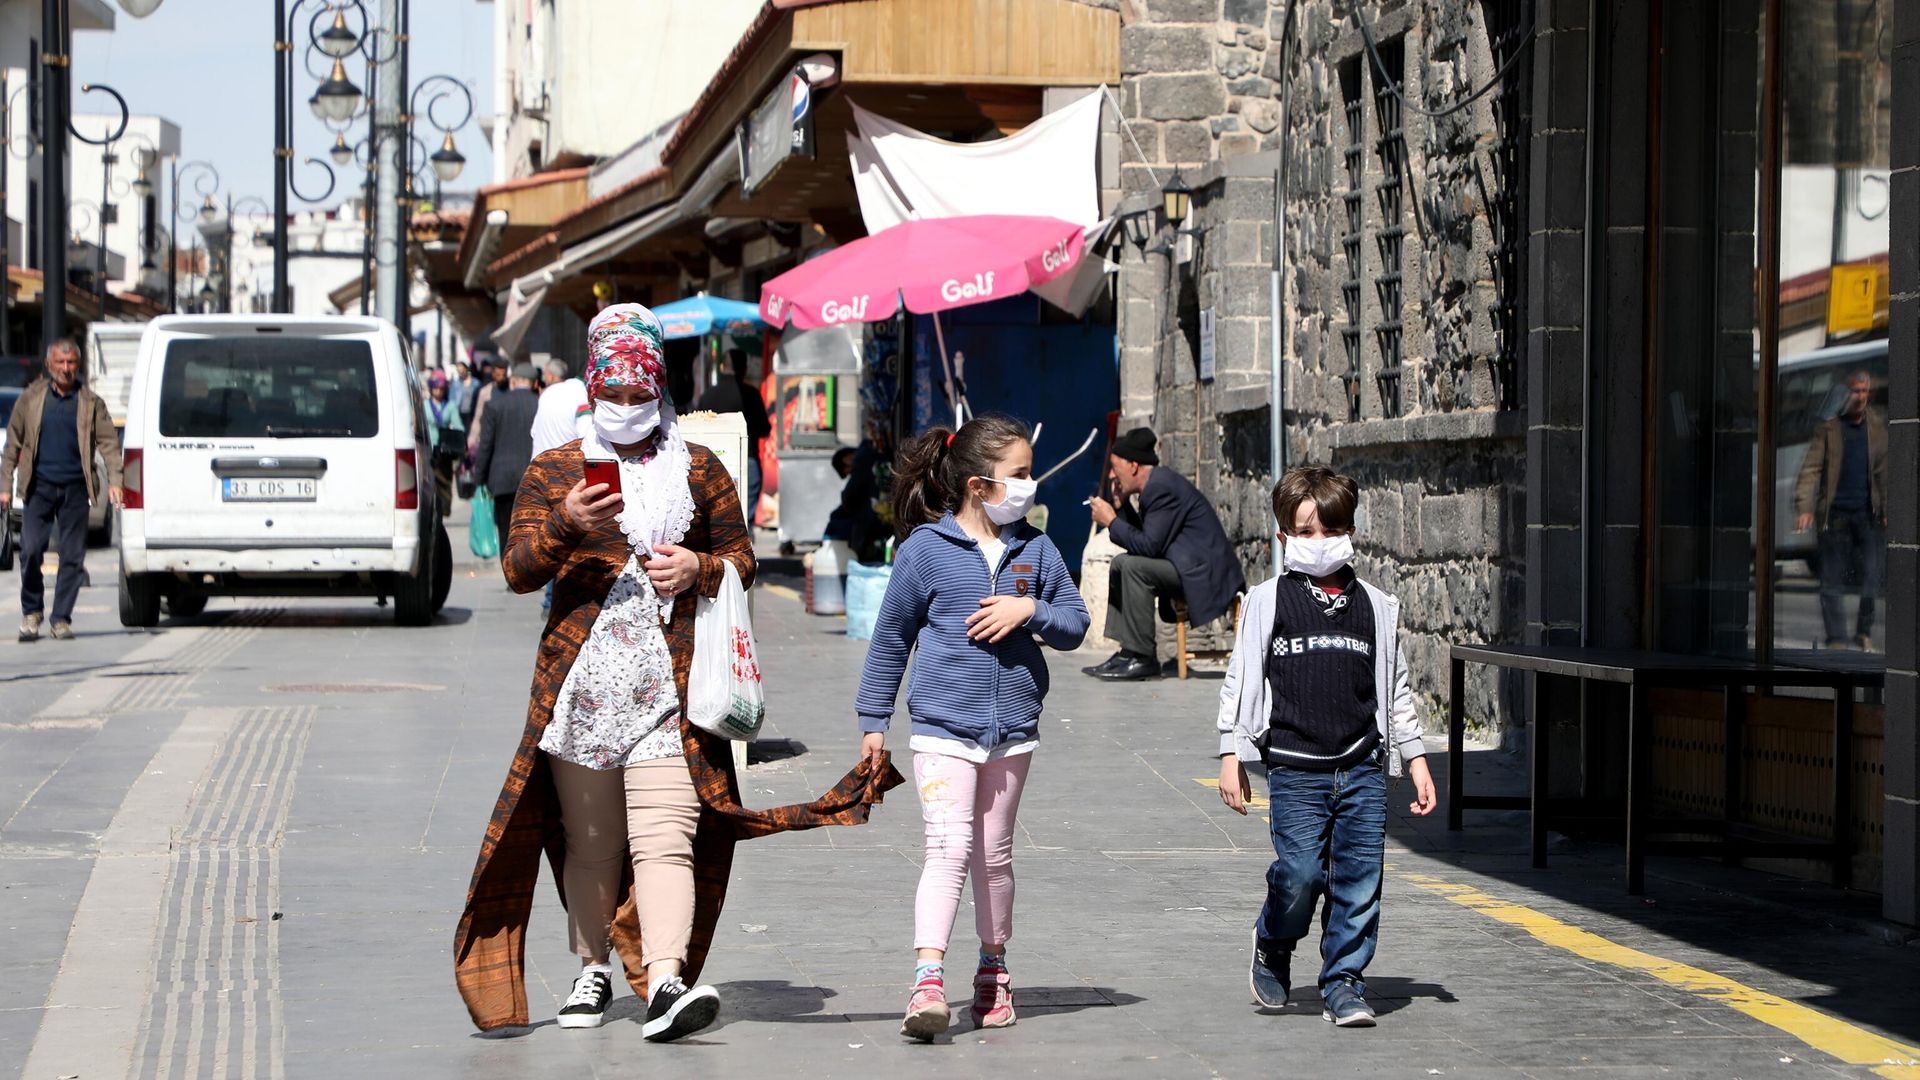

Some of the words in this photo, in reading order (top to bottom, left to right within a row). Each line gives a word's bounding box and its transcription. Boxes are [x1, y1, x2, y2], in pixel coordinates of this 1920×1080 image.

[1042, 238, 1071, 272] Golf
[941, 271, 995, 302] Golf
[767, 294, 784, 318] Golf
[821, 294, 870, 324] Golf
[231, 480, 248, 496] 33
[259, 480, 285, 496] CDS
[296, 480, 312, 496] 16
